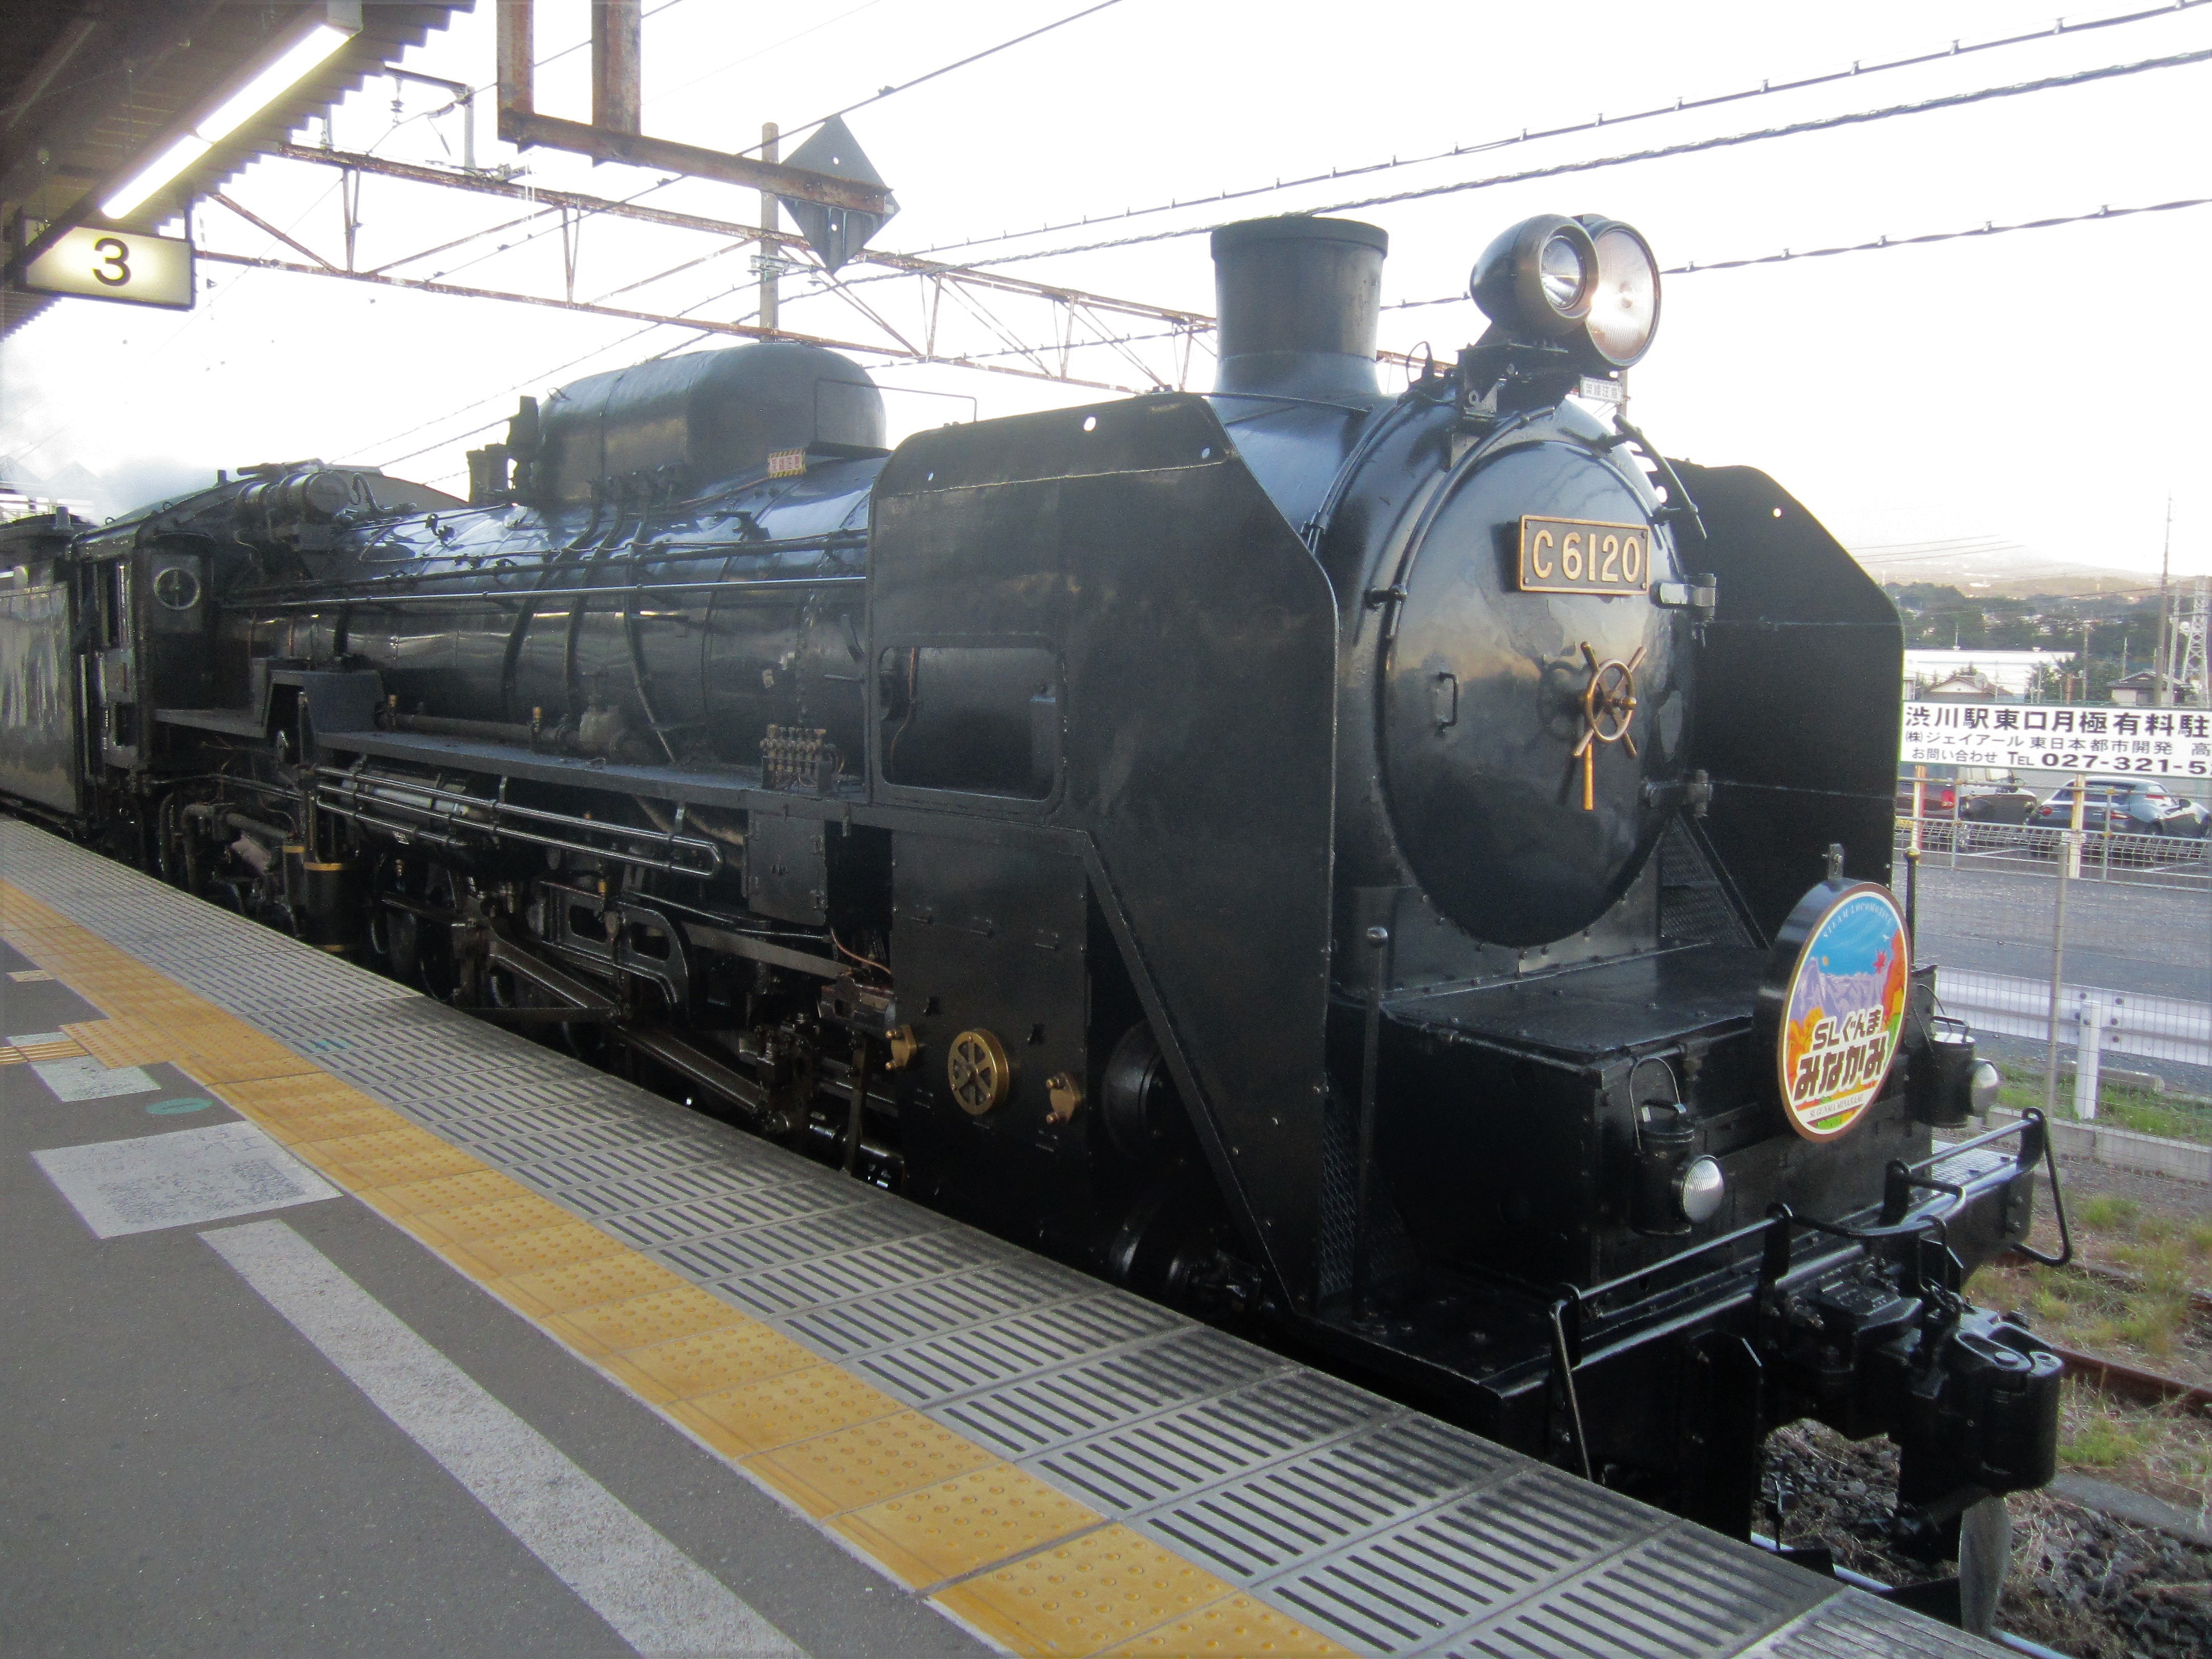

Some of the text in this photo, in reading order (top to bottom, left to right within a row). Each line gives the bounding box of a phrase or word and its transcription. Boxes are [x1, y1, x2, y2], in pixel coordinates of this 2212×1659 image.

[93, 237, 132, 287] 3
[1905, 706, 2210, 738] 渋川駅東口月極有料駐
[1912, 747, 2212, 775] お問い合わせ TEL 027-321-5
[1794, 1035, 1888, 1101] みなかみ
